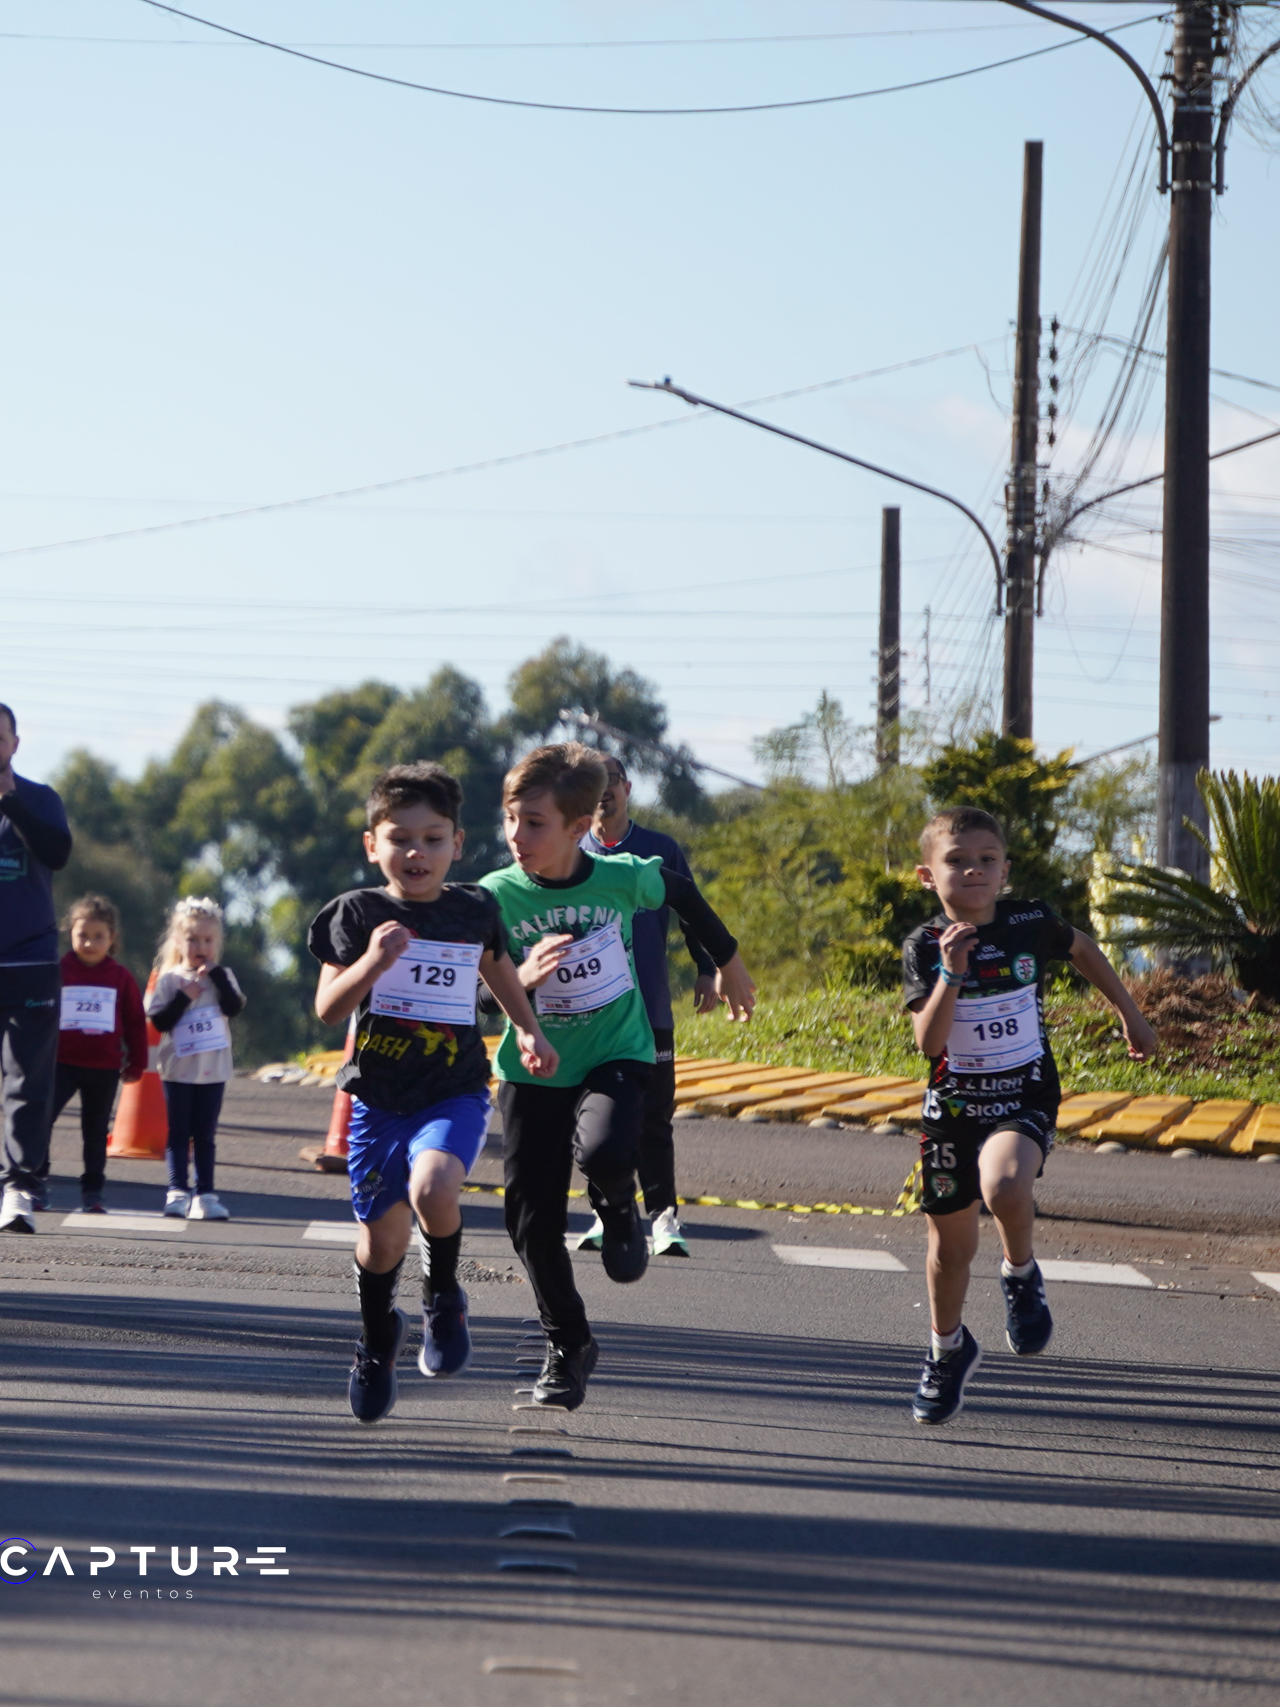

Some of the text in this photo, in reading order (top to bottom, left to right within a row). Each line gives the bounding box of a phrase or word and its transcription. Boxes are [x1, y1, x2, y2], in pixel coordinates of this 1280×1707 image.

[511, 905, 623, 939] CALIFORNIA
[410, 964, 457, 988] 129
[556, 957, 602, 984] 049
[187, 1020, 214, 1034] 183
[973, 1018, 1020, 1042] 198
[930, 1142, 958, 1170] 15
